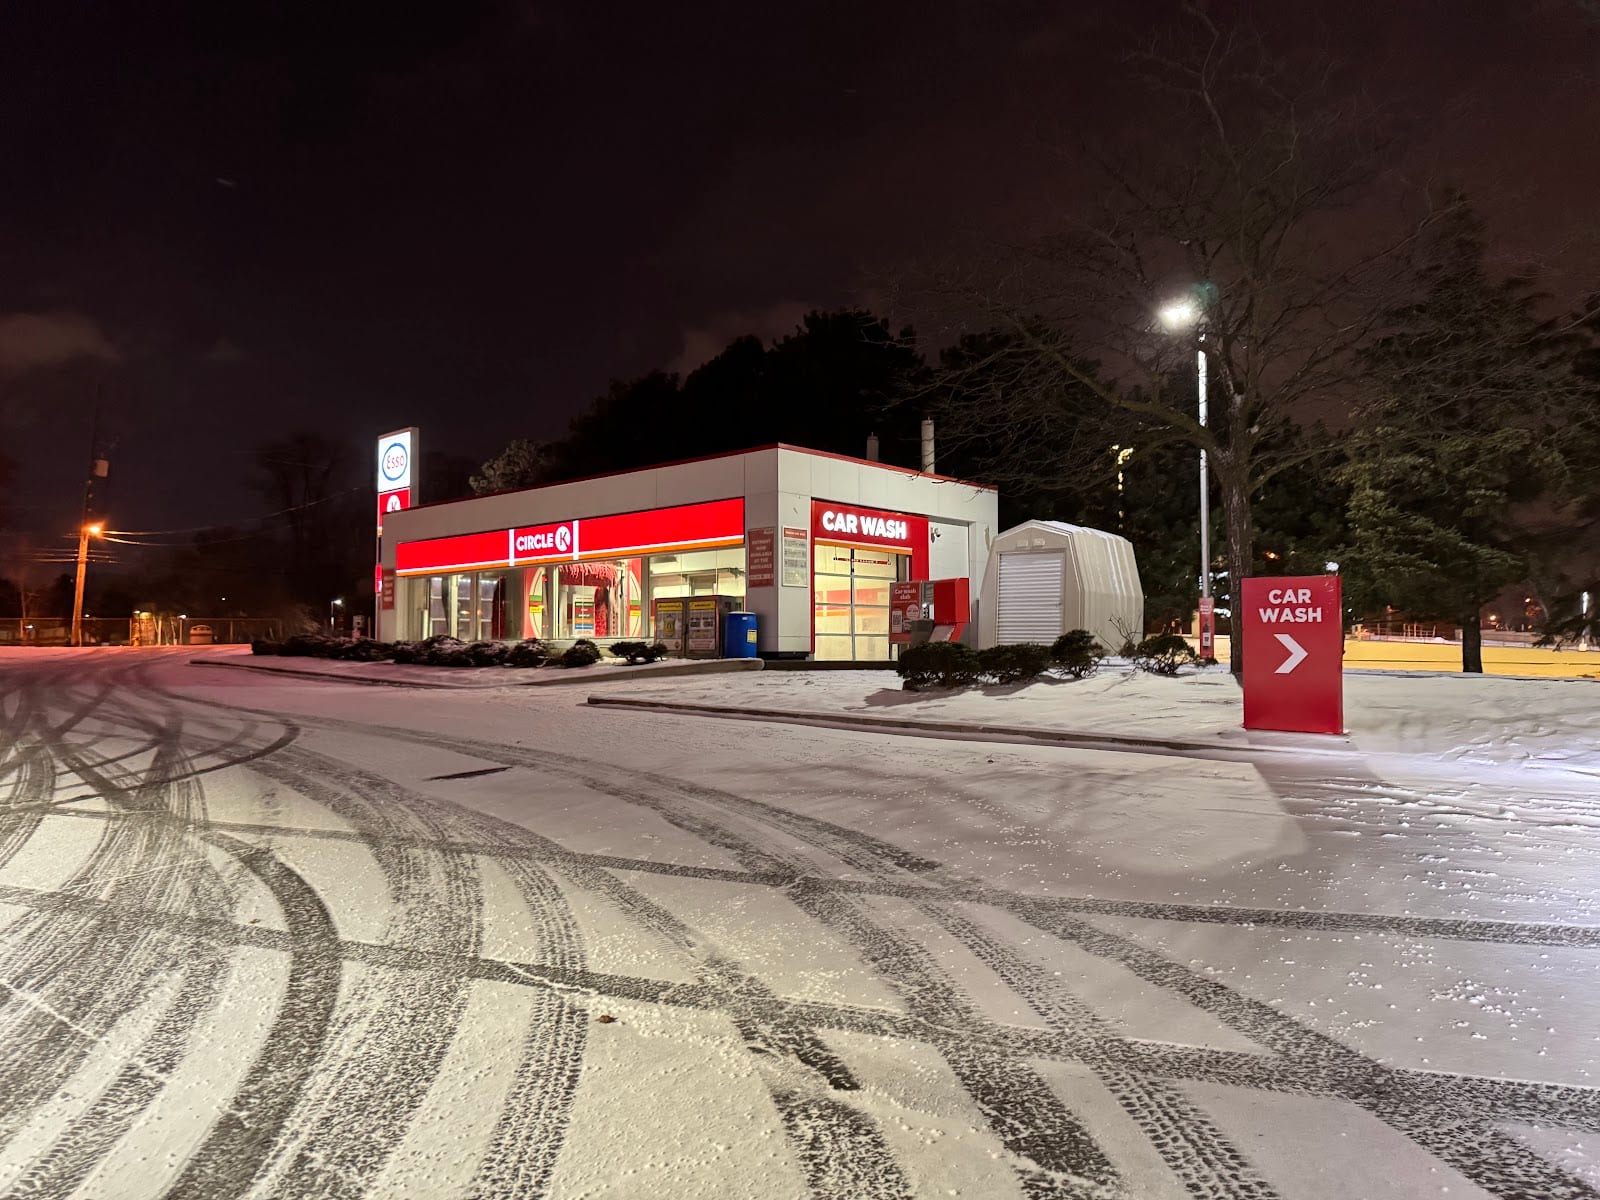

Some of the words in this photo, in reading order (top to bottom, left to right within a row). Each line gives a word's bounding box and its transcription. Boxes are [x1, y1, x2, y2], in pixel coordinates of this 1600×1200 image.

[822, 510, 858, 534] CAR
[860, 515, 907, 540] WASH
[516, 532, 554, 551] CIRCLE
[1268, 588, 1312, 604] CAR
[1258, 607, 1322, 623] WASH
